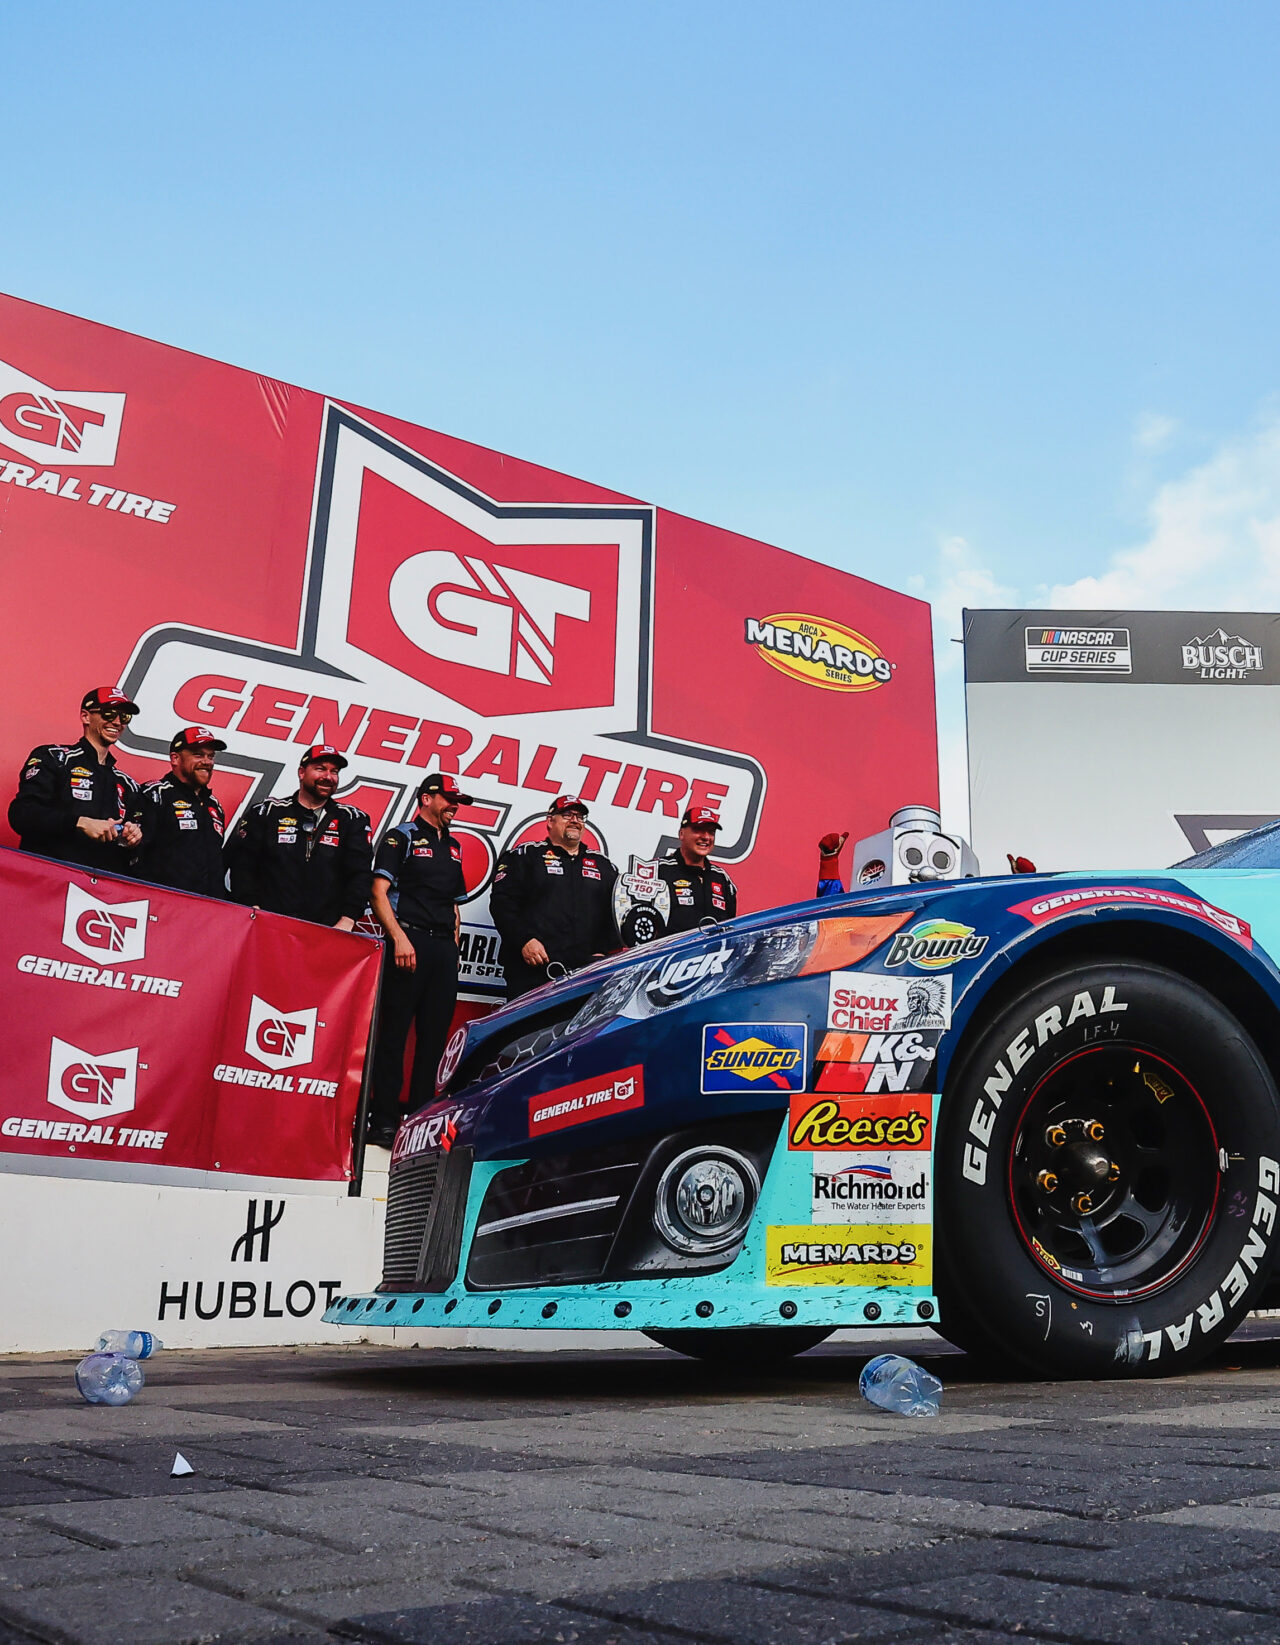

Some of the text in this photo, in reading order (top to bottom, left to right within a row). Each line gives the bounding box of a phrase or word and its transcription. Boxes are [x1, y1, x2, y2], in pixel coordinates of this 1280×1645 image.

[87, 483, 177, 524] TIRE
[388, 549, 591, 686] GT
[798, 622, 818, 637] ARCA
[745, 618, 892, 683] MENARDS
[1057, 631, 1115, 645] NASCAR
[1040, 651, 1117, 664] CUP SERIES
[1181, 645, 1264, 671] BUSCH
[825, 668, 853, 683] SERIES
[1199, 667, 1248, 679] LIGHT
[172, 673, 730, 827] GENERAL TIRE
[634, 884, 653, 894] 150
[1031, 889, 1201, 915] GENERAL TIRE
[885, 933, 989, 967] Bounty
[16, 954, 183, 998] GENERAL TIRE
[646, 949, 734, 992] JGR
[833, 989, 899, 1012] Sioux
[831, 1009, 892, 1031] Chief
[710, 1050, 798, 1069] SUNOCO
[213, 1064, 339, 1099] GENERAL TIRE
[962, 985, 1129, 1186] GENERAL
[533, 1096, 584, 1123] GENERAL
[585, 1088, 614, 1107] TIRE
[1, 1117, 169, 1150] GENERAL TIRE
[790, 1100, 929, 1146] Reese's
[814, 1172, 927, 1200] Richmond
[831, 1201, 926, 1212] The Water Heater Experts
[781, 1243, 917, 1265] MENARDS
[1143, 1155, 1280, 1361] GENERAL
[158, 1280, 342, 1320] HUBLOT
